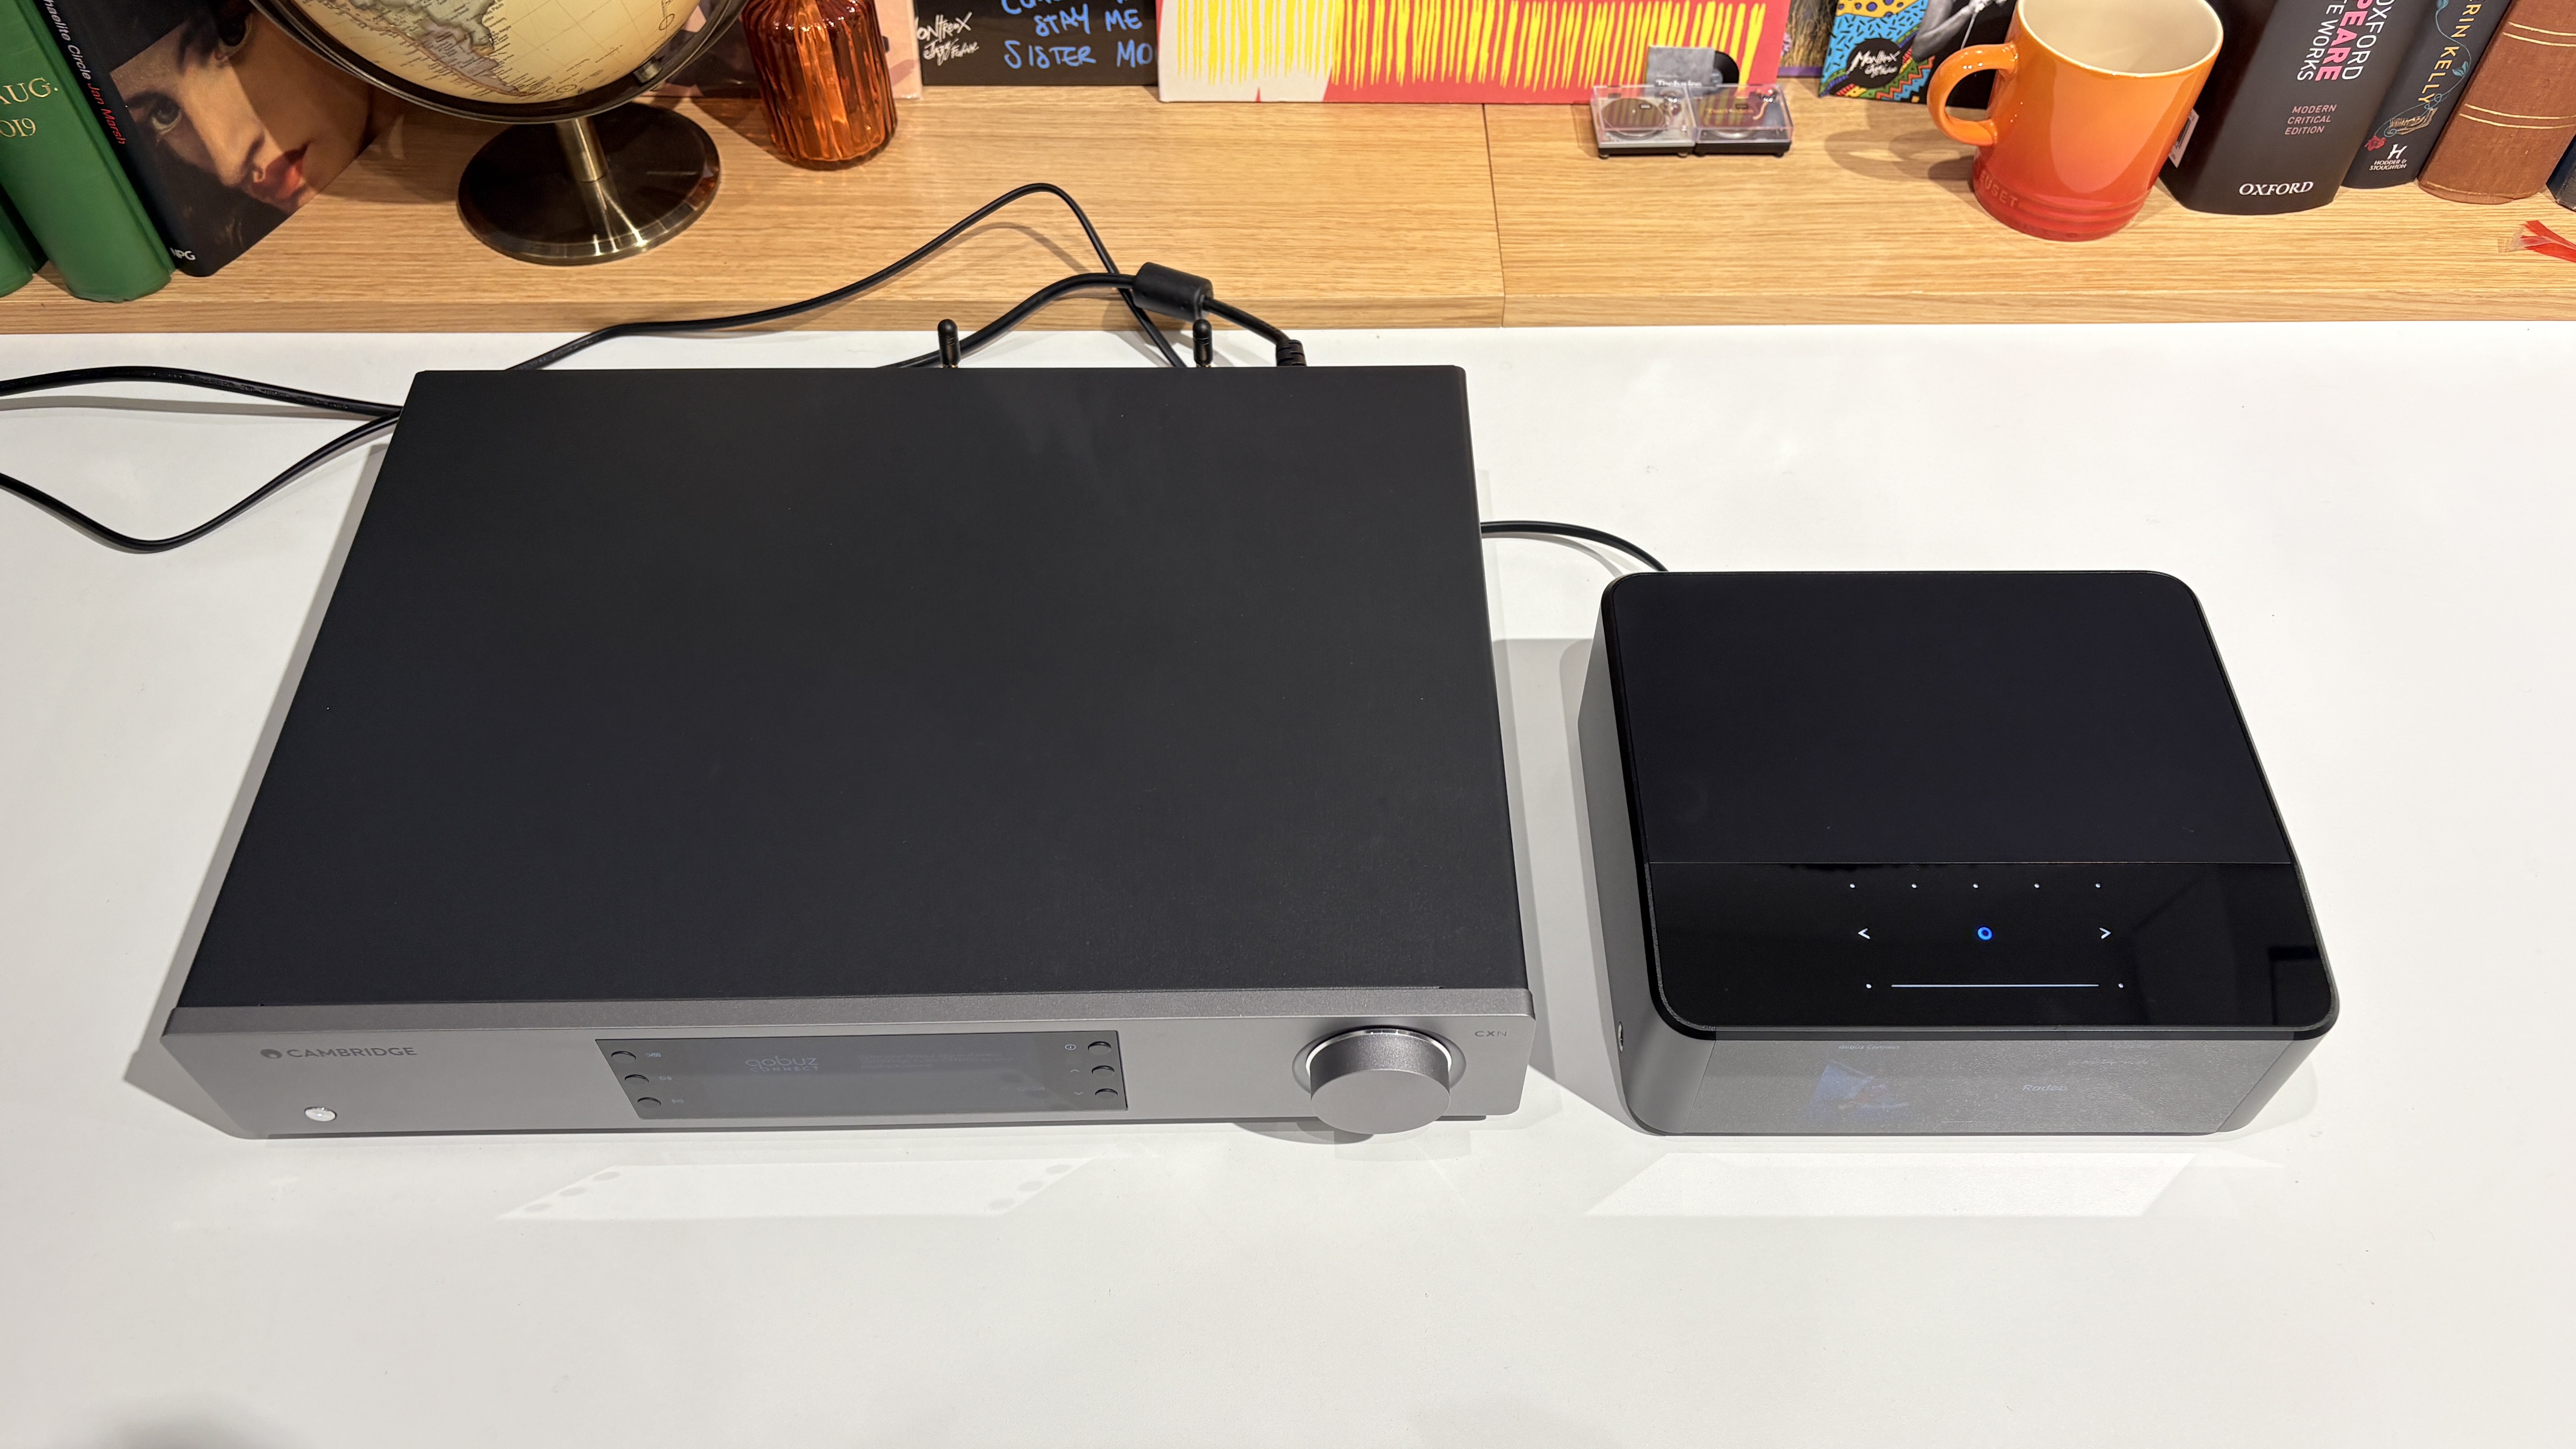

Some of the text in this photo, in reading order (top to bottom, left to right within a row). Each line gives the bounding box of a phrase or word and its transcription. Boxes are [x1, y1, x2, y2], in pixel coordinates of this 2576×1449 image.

[1034, 4, 1090, 37] STAY
[1105, 9, 1142, 32] ME
[2297, 0, 2347, 80] E WORKS
[1004, 39, 1157, 69] SISTER MO
[2418, 0, 2485, 104] RIN KELLY
[68, 45, 91, 80] Circle
[87, 83, 127, 145] Jan Marsh
[2292, 104, 2337, 114] MODERN
[2287, 115, 2331, 124] CRITICAL
[2284, 126, 2325, 135] EDITION
[2387, 144, 2408, 160] H
[2239, 181, 2314, 196] OXFORD
[287, 1048, 417, 1058] CAMBRIDGE
[745, 1055, 818, 1072] qobuz
